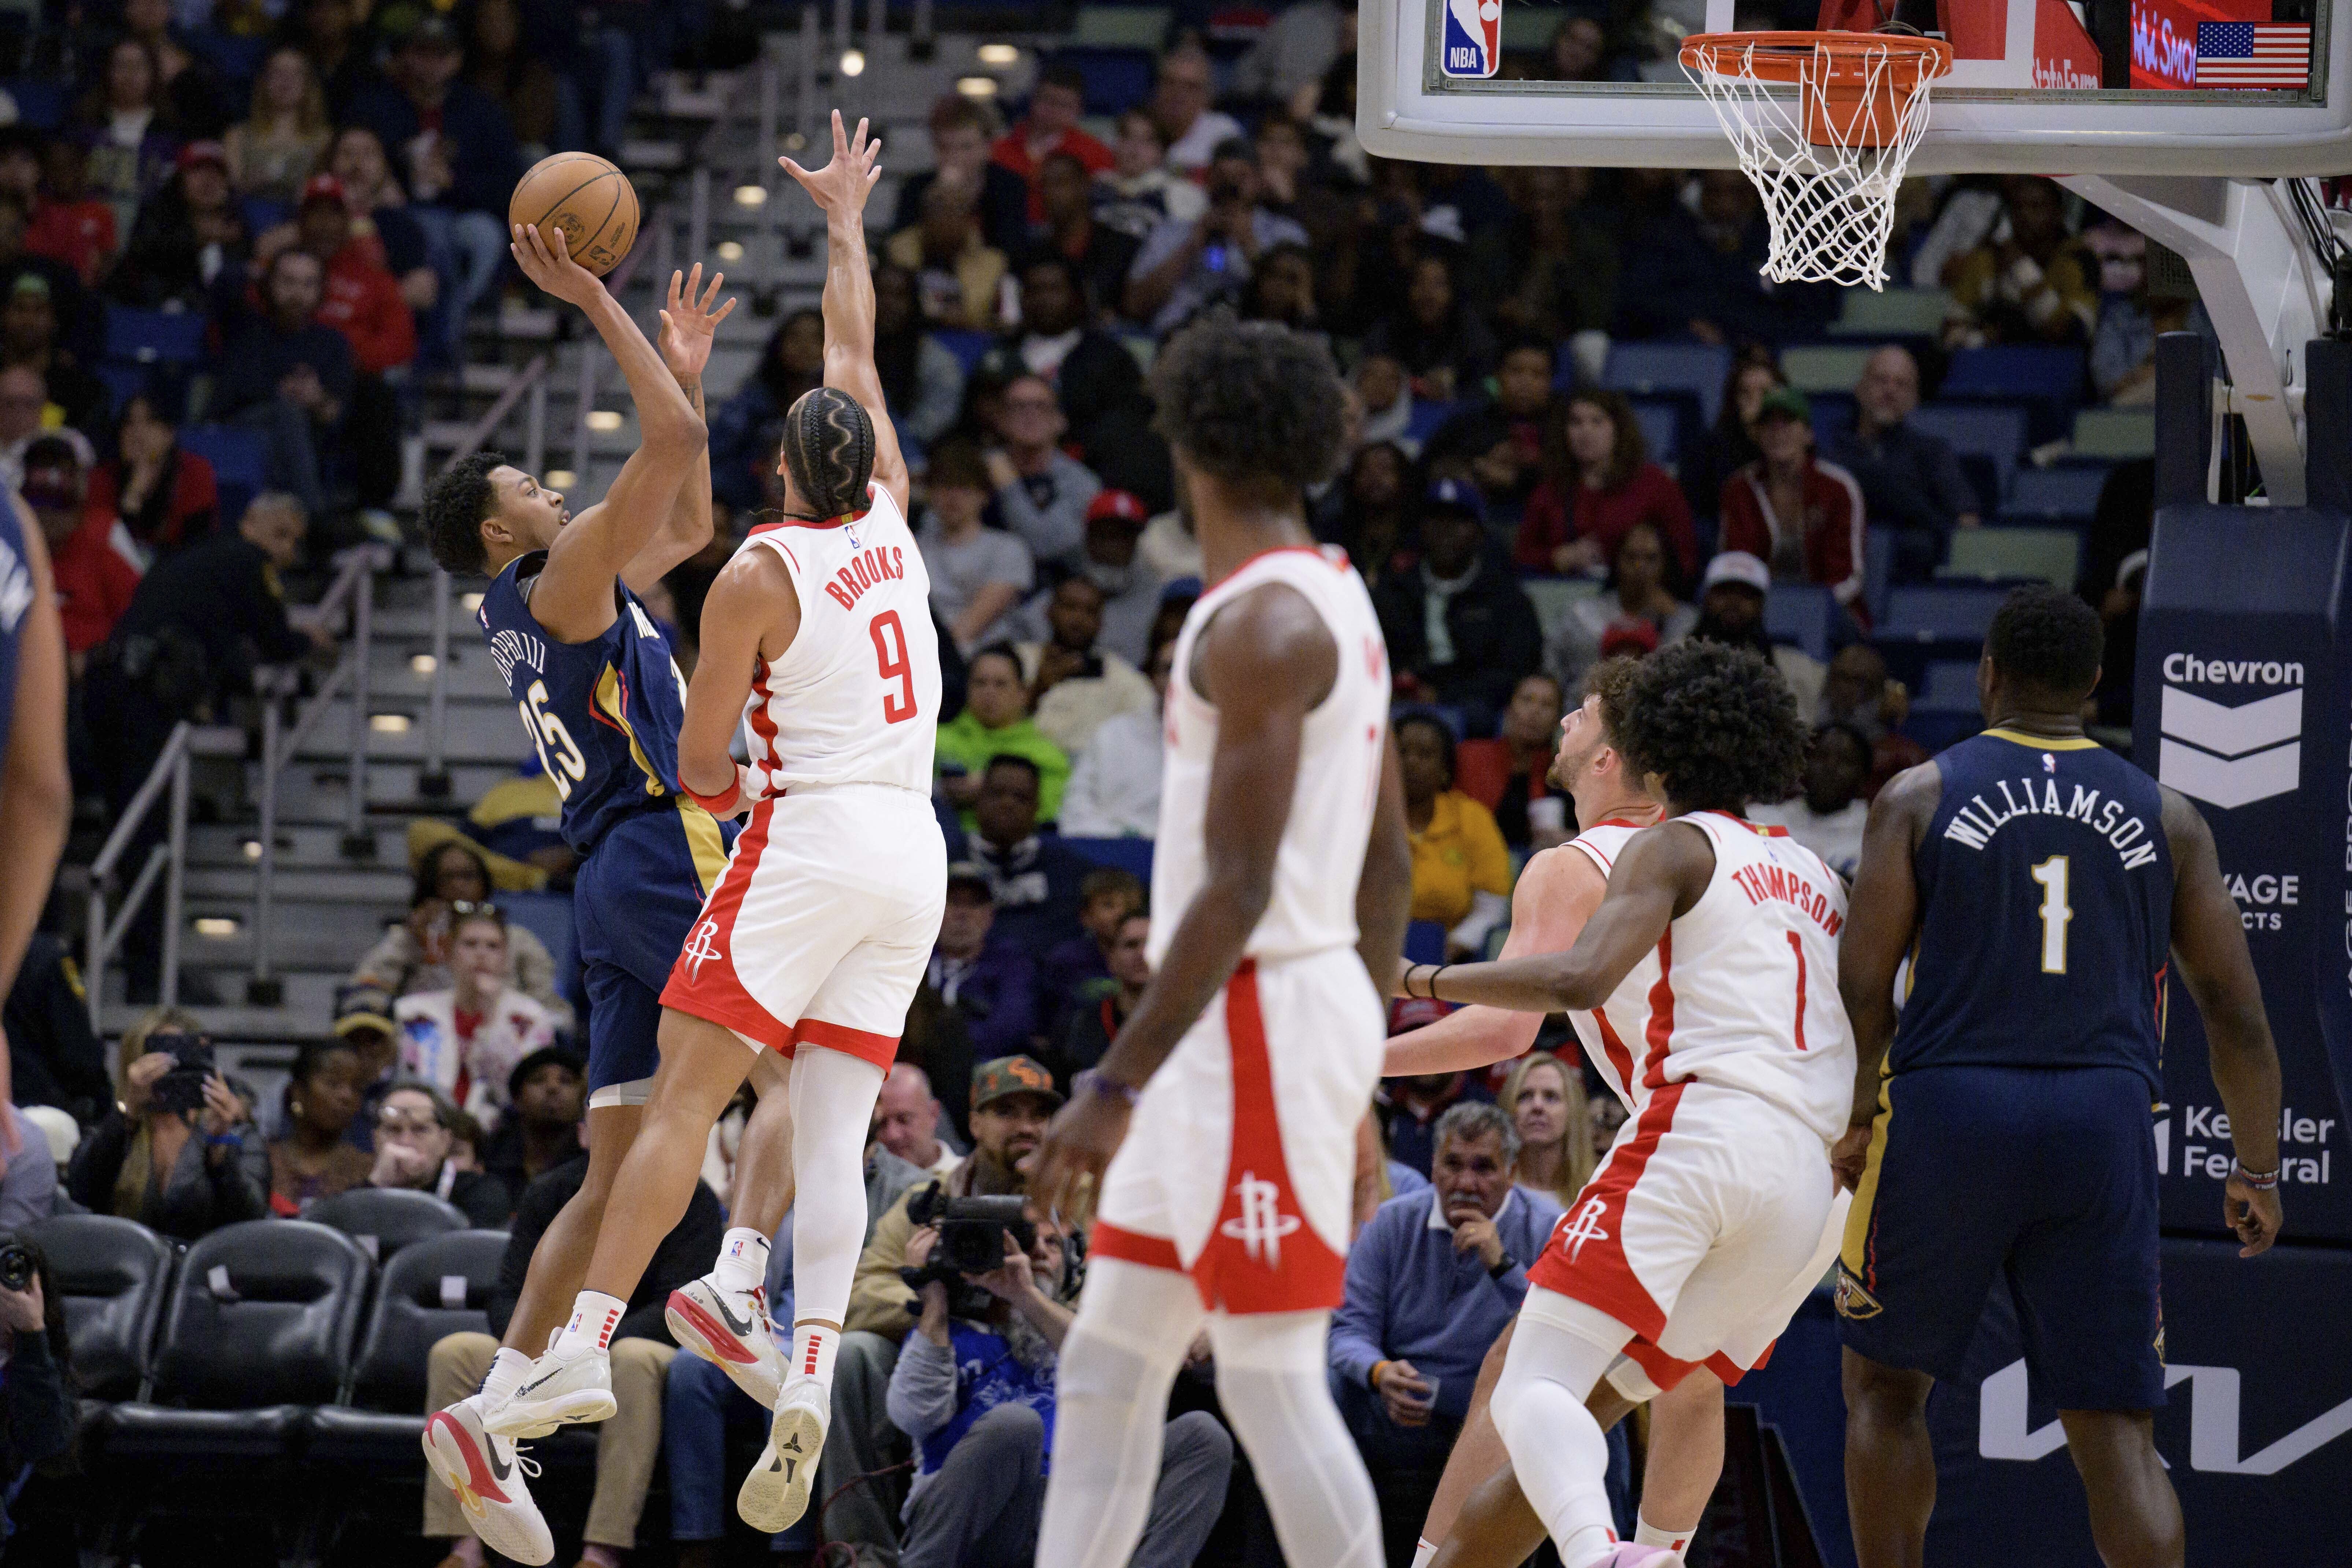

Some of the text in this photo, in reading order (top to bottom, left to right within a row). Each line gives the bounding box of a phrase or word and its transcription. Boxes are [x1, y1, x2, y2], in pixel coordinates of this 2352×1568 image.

[1450, 47, 1477, 68] NBA
[825, 546, 903, 611] BROOKS
[491, 630, 525, 697] URPHY
[870, 609, 917, 724] 9
[2163, 653, 2304, 684] Chevron
[519, 679, 586, 801] 25
[1944, 778, 2157, 870] WILLIAMSON
[2031, 855, 2074, 974] 1
[1786, 930, 1807, 1051] 1
[2185, 1105, 2335, 1143] Keler
[2184, 1145, 2330, 1184] Feral
